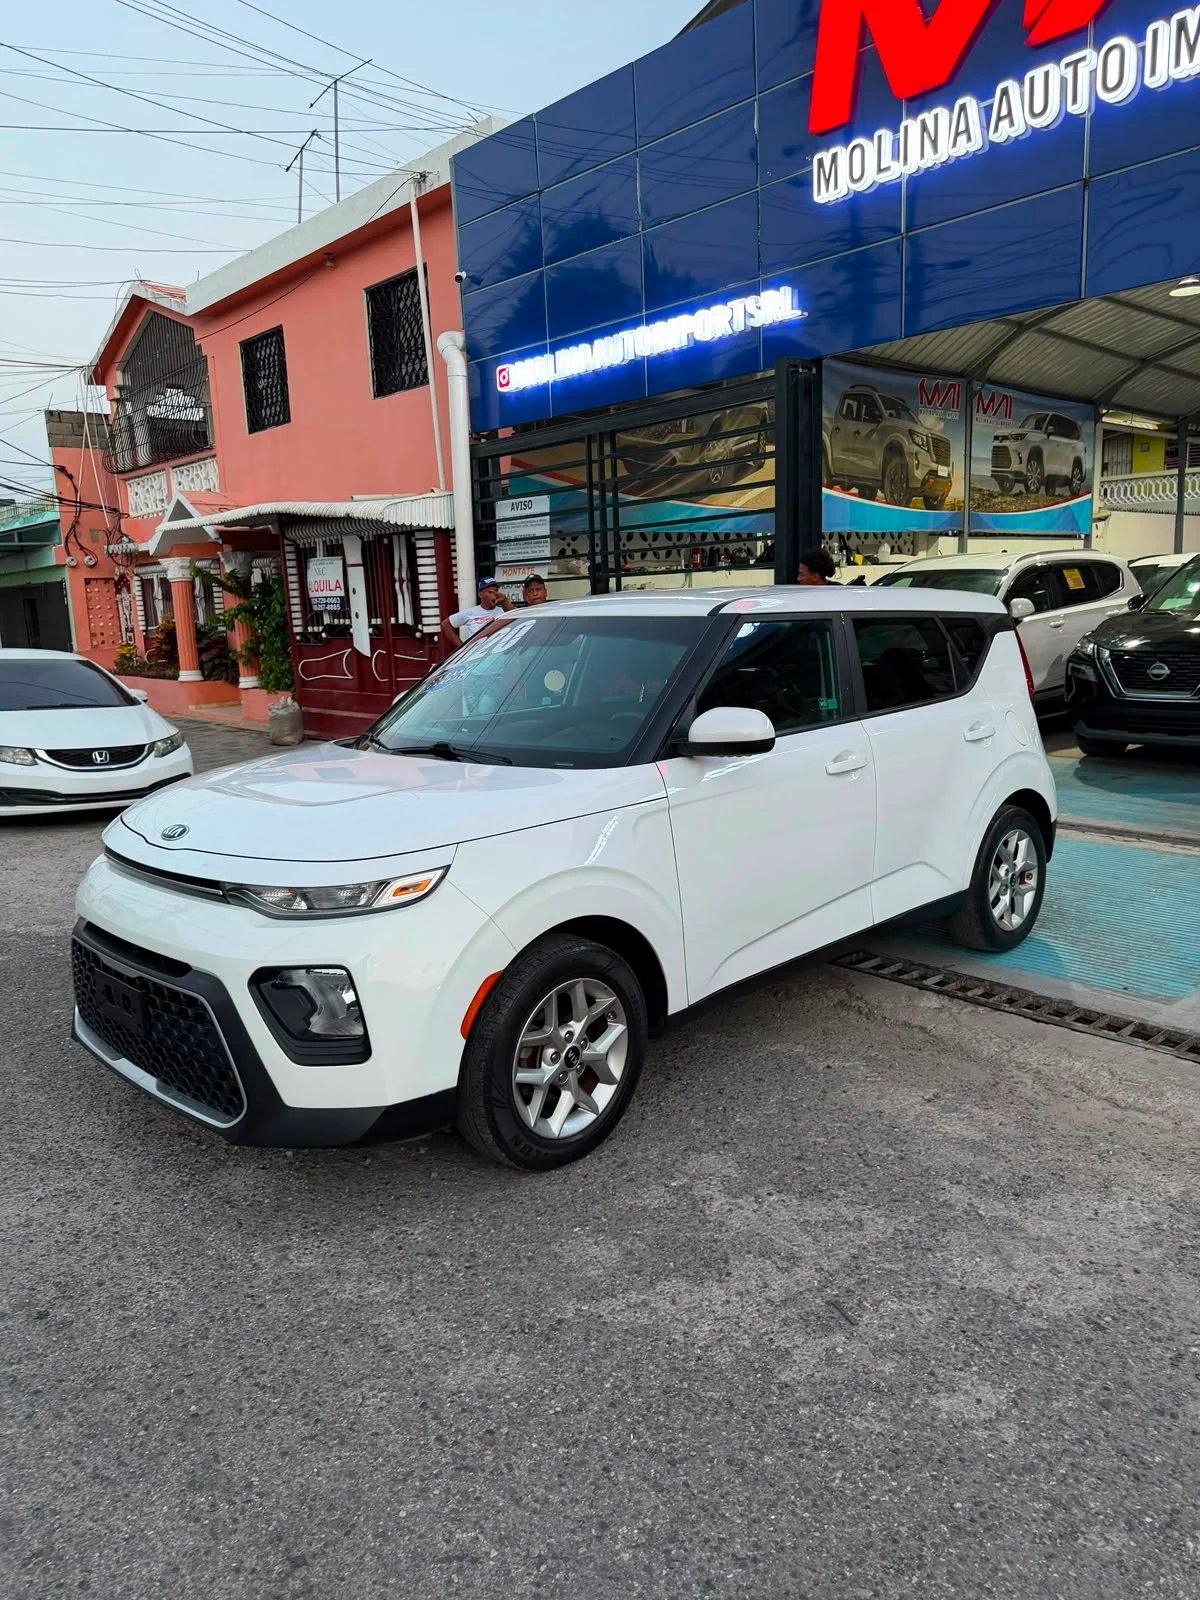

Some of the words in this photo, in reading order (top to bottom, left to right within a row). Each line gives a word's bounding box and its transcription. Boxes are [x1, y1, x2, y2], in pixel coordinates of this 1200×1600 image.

[813, 97, 985, 204] MOLINA
[988, 35, 1138, 143] AUTO
[510, 500, 533, 512] AVISO
[502, 566, 535, 577] MONTATE
[503, 591, 521, 602] ÁCIL
